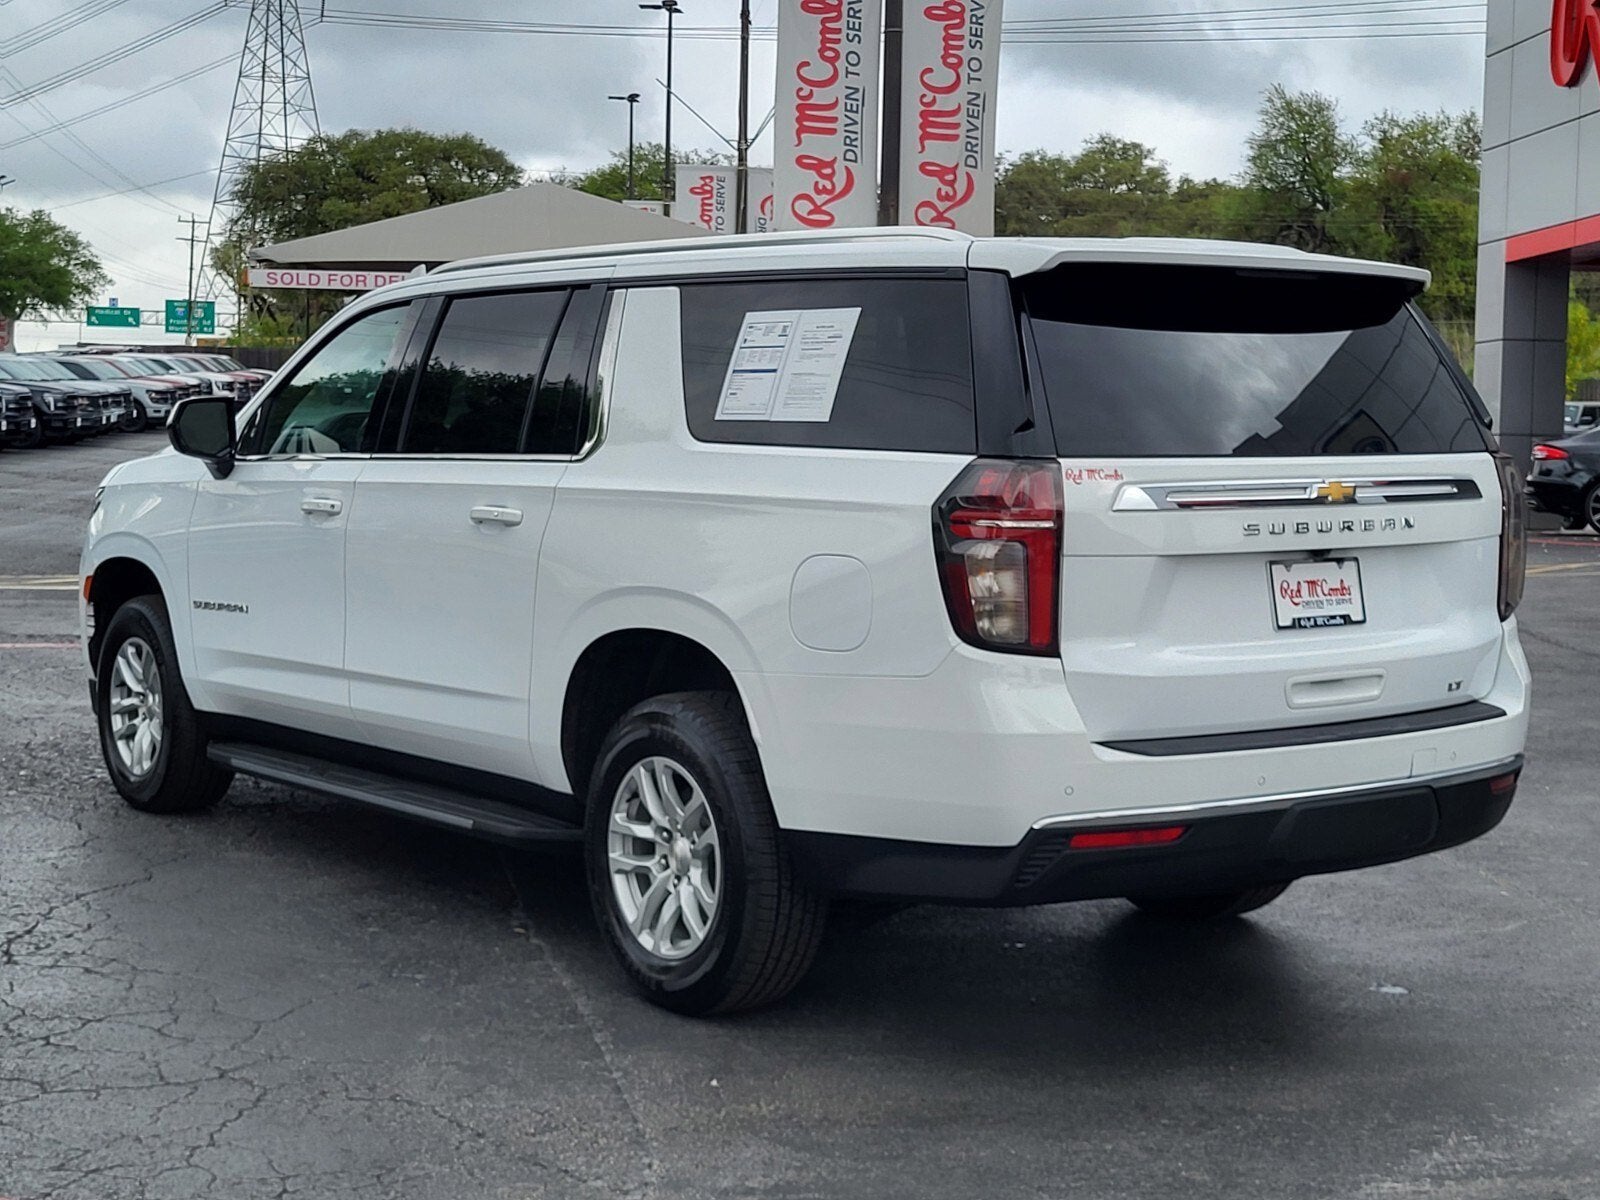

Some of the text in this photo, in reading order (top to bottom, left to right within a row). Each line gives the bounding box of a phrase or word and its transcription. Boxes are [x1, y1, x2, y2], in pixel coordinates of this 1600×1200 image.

[845, 50, 861, 79] TO
[964, 0, 985, 170] DRIVEN TO SERV
[791, 0, 855, 228] Red McComb
[843, 85, 860, 164] DRIVEN
[914, 0, 975, 230] Red McComb
[715, 175, 726, 232] TO SERVE
[266, 271, 405, 288] SOLD FOR DE
[1065, 468, 1083, 485] Red
[1243, 516, 1416, 537] SUBURBAN
[1280, 578, 1352, 606] Red McCombs
[1301, 597, 1354, 609] DRIVEN TO SERVE
[192, 600, 249, 614] SUBURBAN
[1447, 680, 1464, 692] LT
